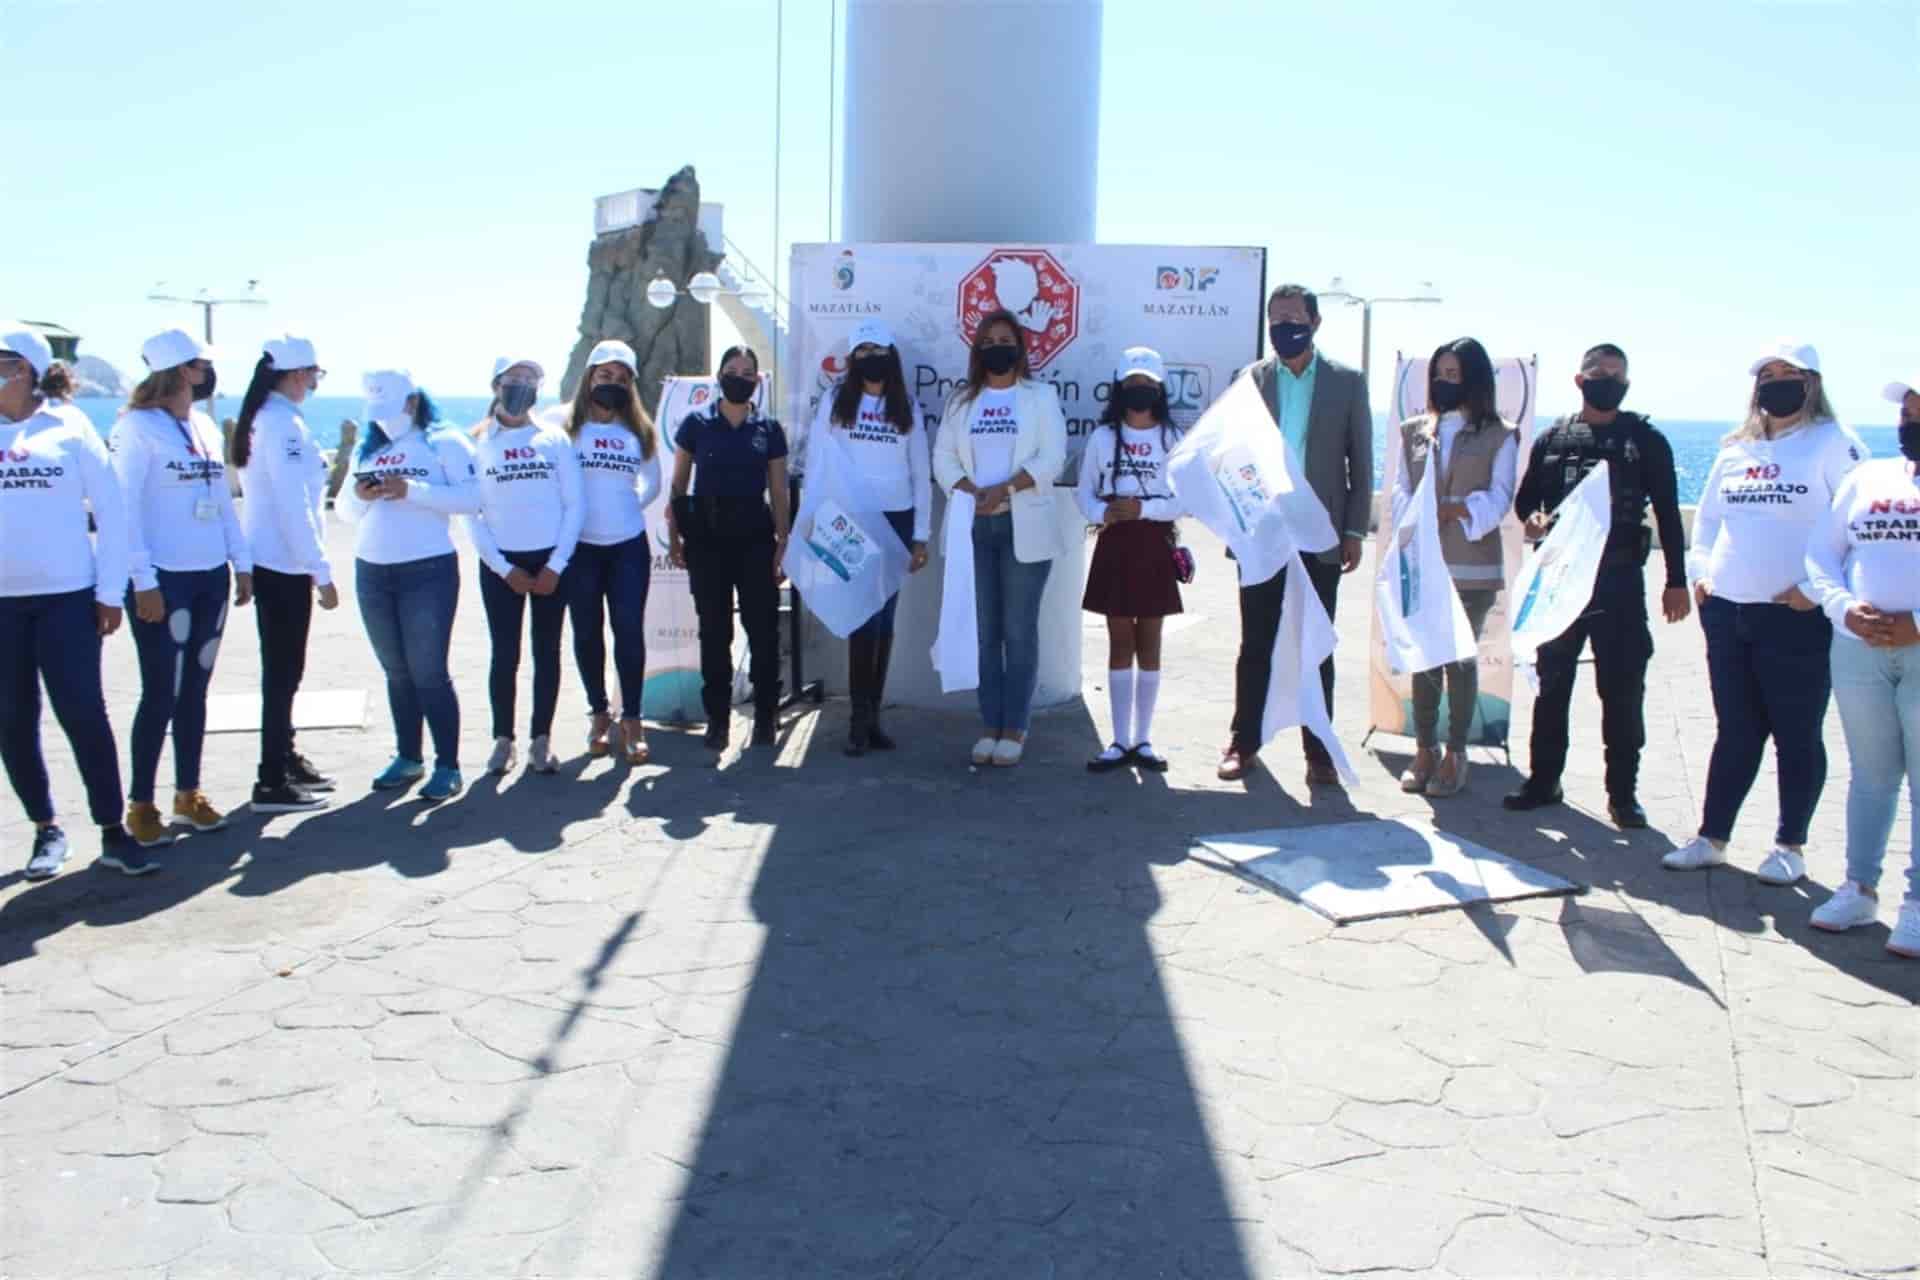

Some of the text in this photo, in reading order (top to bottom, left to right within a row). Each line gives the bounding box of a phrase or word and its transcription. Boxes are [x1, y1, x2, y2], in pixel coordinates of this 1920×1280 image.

[808, 300, 881, 313] MAZATLÁN
[1144, 302, 1230, 316] MAZATLÁN
[594, 438, 625, 450] NO
[504, 446, 536, 461] NO
[1745, 464, 1780, 480] NO
[1727, 494, 1793, 504] INFANTIL
